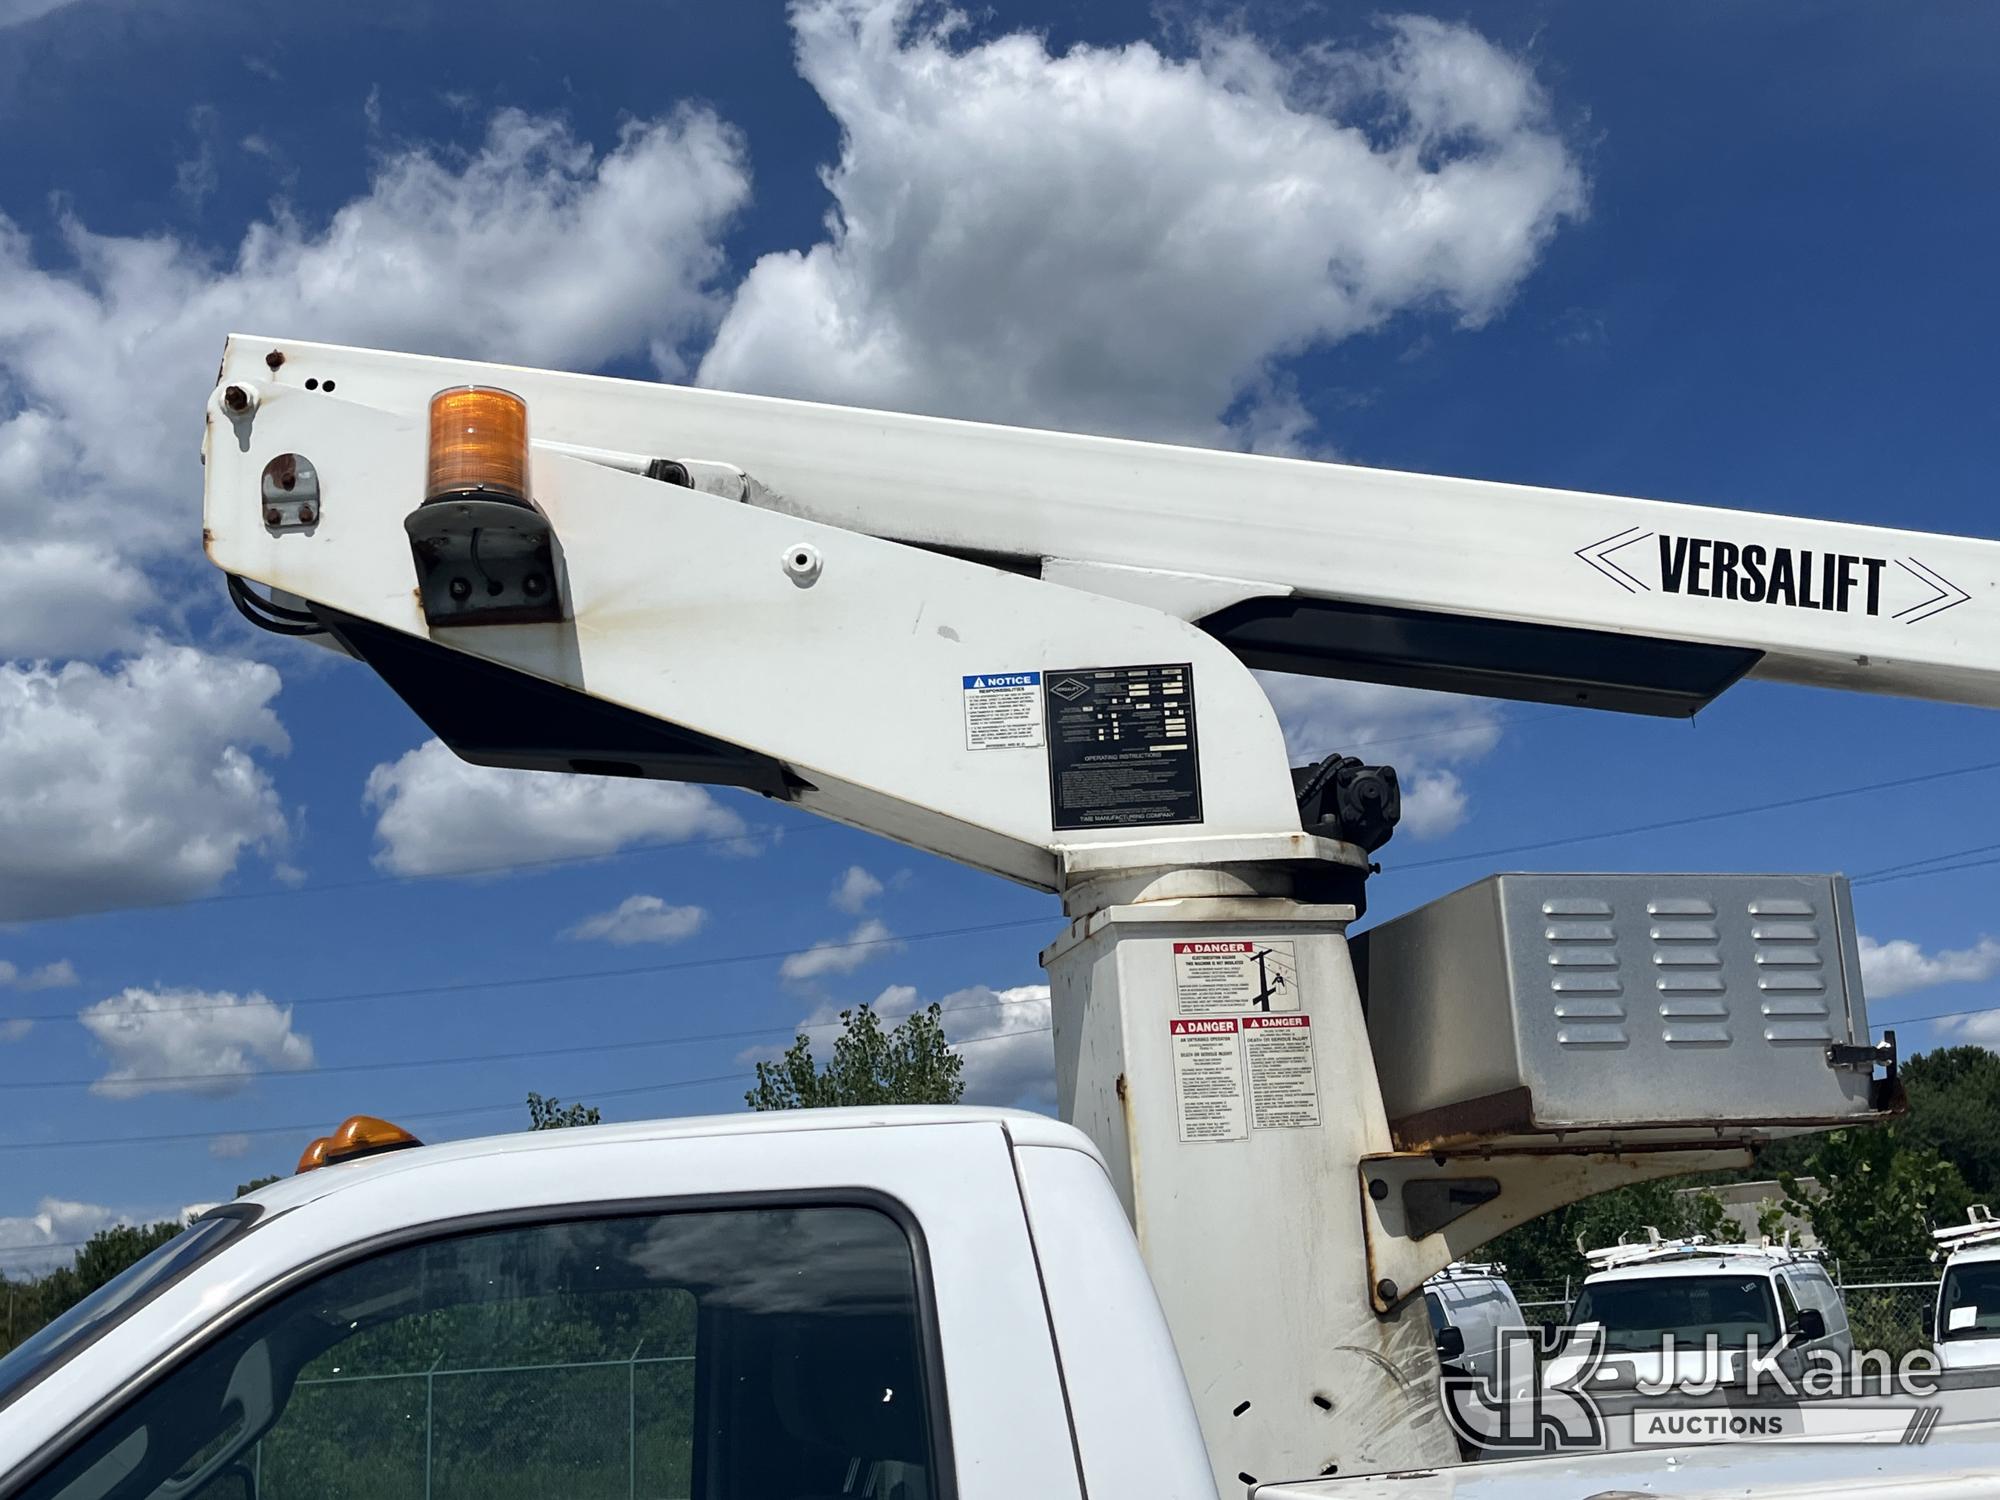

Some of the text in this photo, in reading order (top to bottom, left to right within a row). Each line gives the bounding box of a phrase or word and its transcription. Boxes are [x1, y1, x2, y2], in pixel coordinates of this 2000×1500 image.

[1658, 534, 1886, 616] VERSALIFT
[988, 676, 1032, 686] NOTICE
[1194, 943, 1245, 952] DANGER
[1188, 1021, 1235, 1032] DANGER
[1261, 1018, 1303, 1026] DANGER
